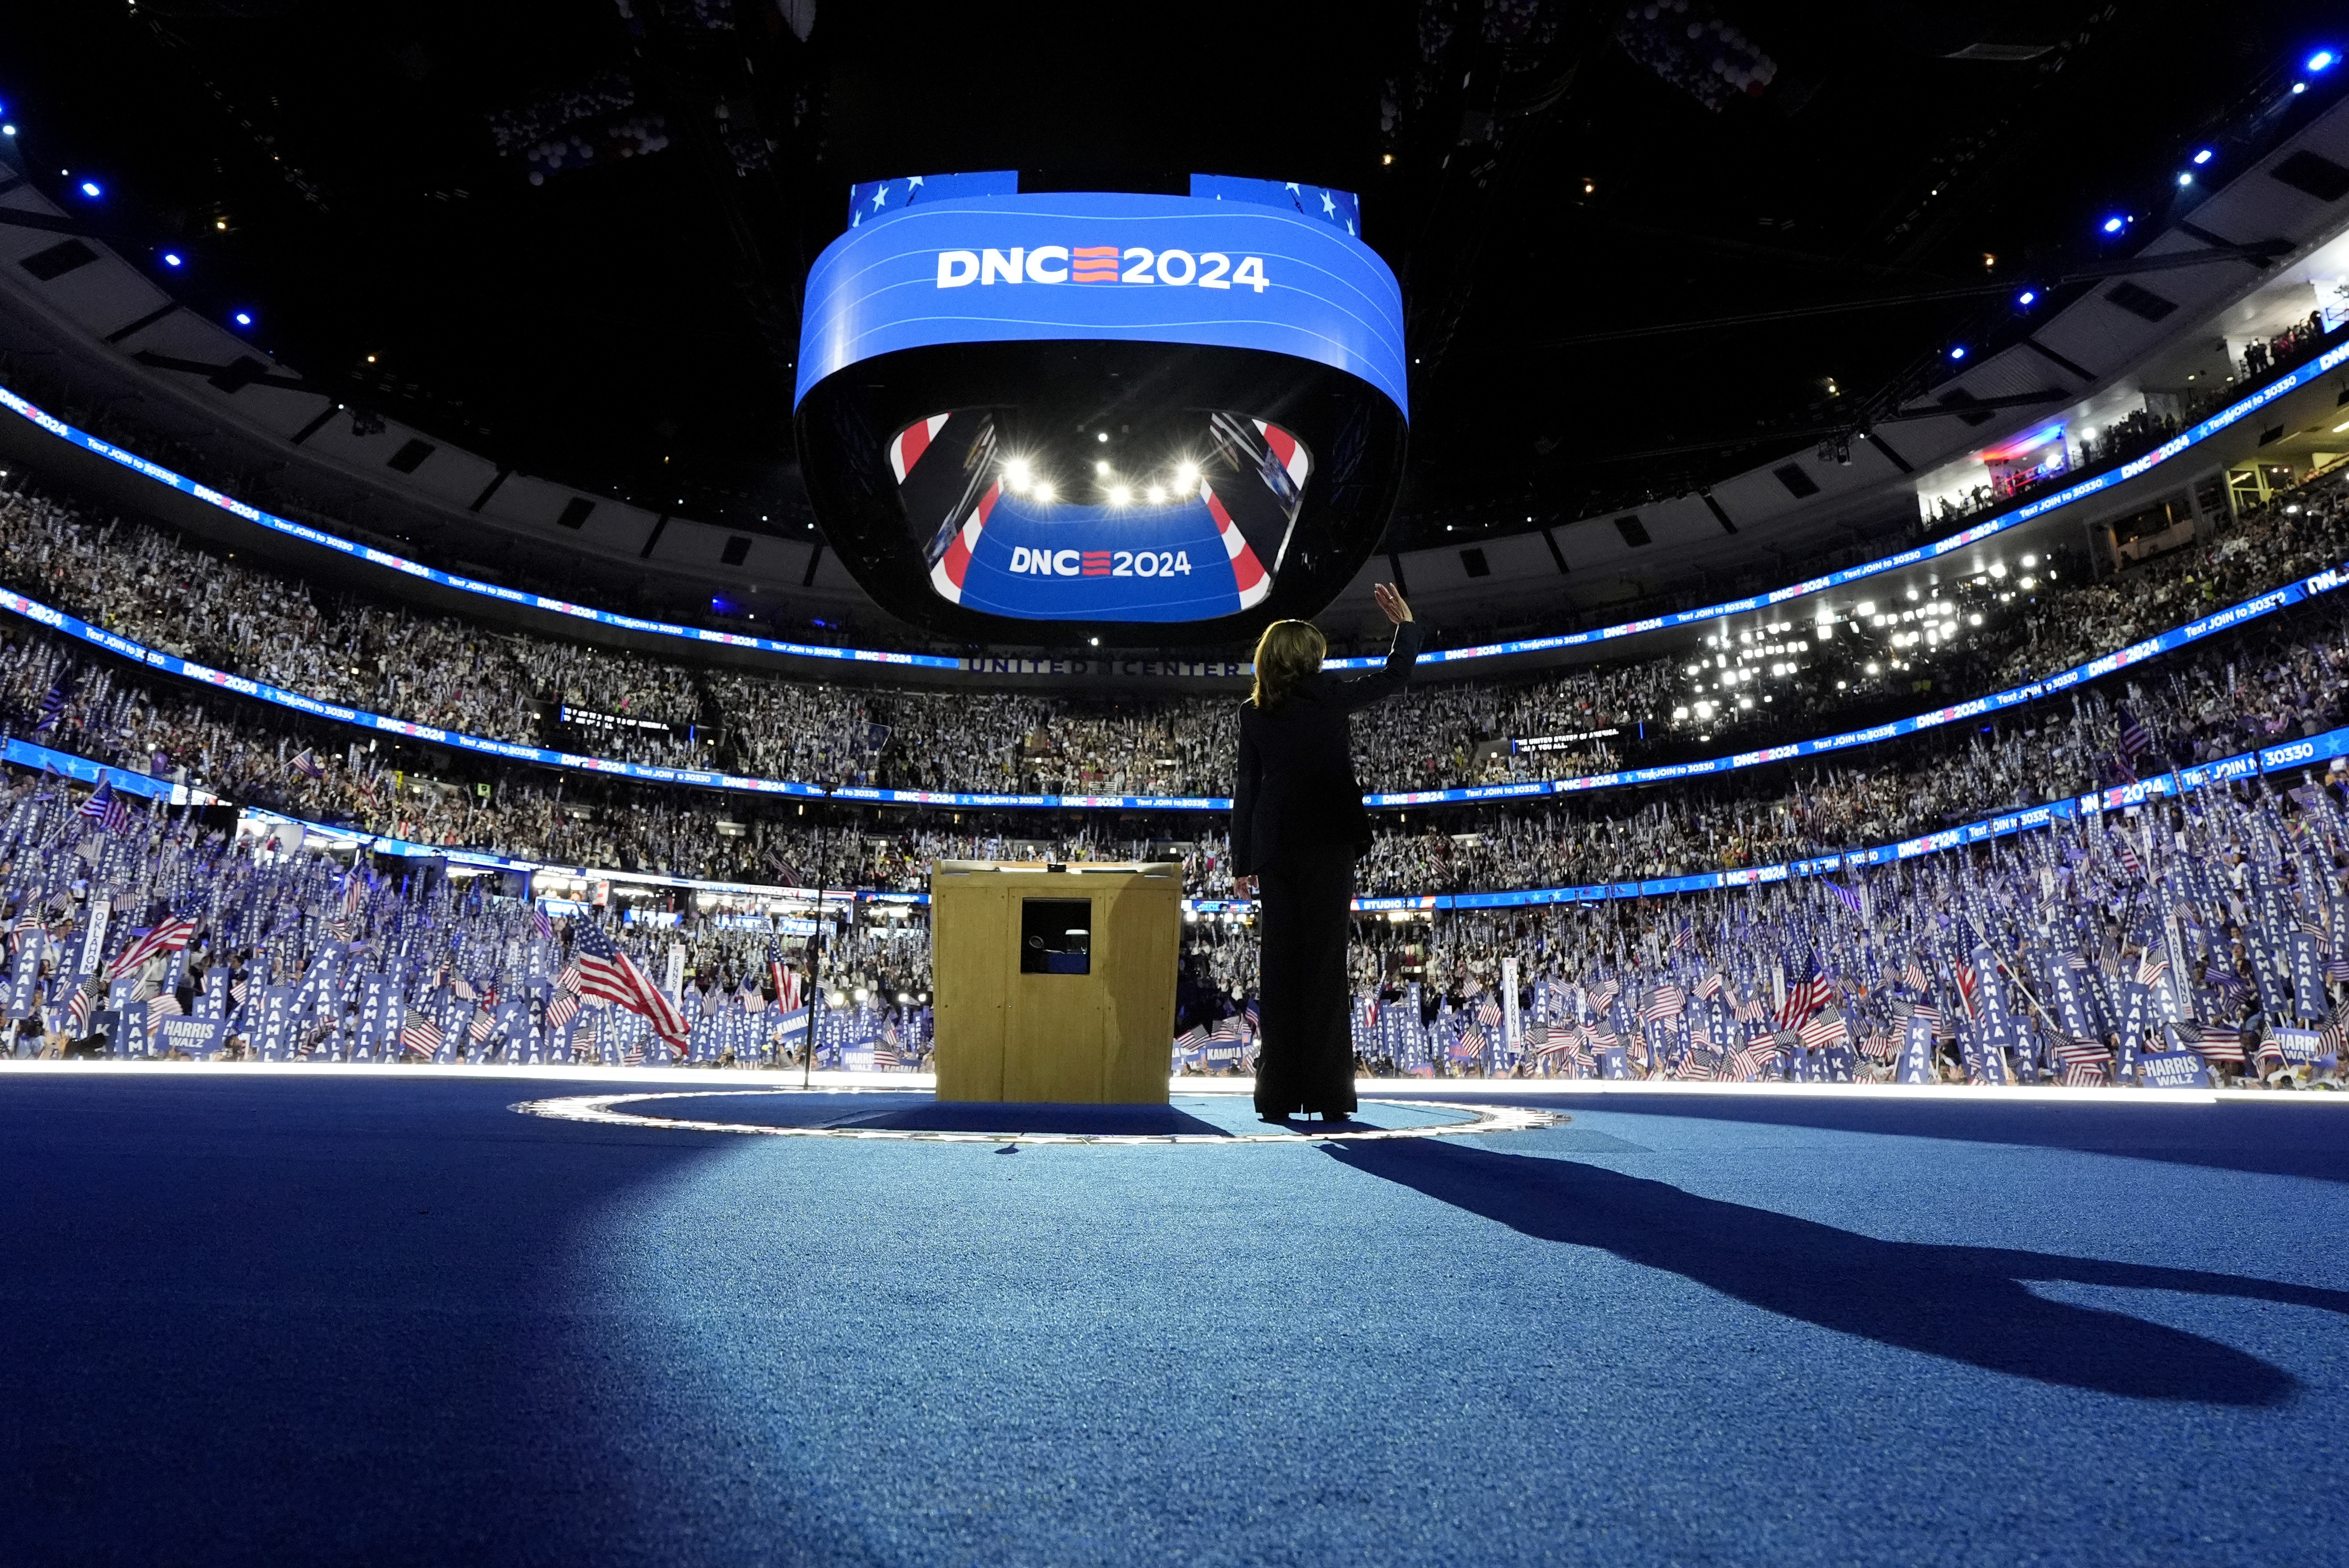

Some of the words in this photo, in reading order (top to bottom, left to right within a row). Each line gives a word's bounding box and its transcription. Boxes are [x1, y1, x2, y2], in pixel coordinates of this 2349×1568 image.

[937, 246, 1068, 288] DNC
[1122, 247, 1270, 293] 2024
[2252, 395, 2264, 405] to
[2264, 375, 2296, 400] 30330
[0, 389, 29, 414] DNC
[34, 411, 68, 436] 2024
[87, 438, 108, 453] Text
[108, 449, 133, 464] JOIN
[133, 459, 143, 469] to
[2121, 455, 2152, 479] DNC
[2158, 435, 2190, 460] 2024
[194, 485, 223, 505] DNC
[229, 501, 259, 521] 2024
[2019, 505, 2038, 518] Text
[2039, 495, 2061, 510] JOIN
[2062, 492, 2072, 501] to
[2073, 479, 2103, 497] 30330
[274, 519, 293, 531] Text
[293, 527, 316, 539] JOIN
[316, 534, 326, 542] to
[326, 536, 353, 551] 30330
[1935, 535, 1962, 554] DNC
[1967, 520, 1999, 541] 2024
[366, 549, 395, 566] DNC
[399, 560, 429, 577] 2024
[1009, 547, 1079, 576] DNC
[1112, 551, 1191, 577] 2024
[1843, 569, 1861, 579] Text
[1861, 562, 1882, 574] JOIN
[1893, 551, 1921, 565] 30330
[1769, 587, 1795, 603] DNC
[1799, 577, 1830, 593] 2024
[26, 602, 62, 627] 2024
[537, 597, 564, 611] DNC
[569, 605, 598, 619] 2024
[2184, 622, 2206, 637] Text
[2208, 611, 2235, 629] JOIN
[2235, 608, 2247, 618] to
[699, 630, 724, 642] DNC
[730, 635, 758, 647] 2024
[1603, 625, 1628, 638] DNC
[1635, 618, 1663, 632] 2024
[855, 650, 879, 661] DNC
[885, 653, 912, 664] 2024
[969, 660, 1088, 674] UNITED
[1123, 661, 1241, 676] CENTER
[1445, 649, 1469, 660] DNC
[1475, 645, 1502, 656] 2024
[2088, 655, 2118, 677] DNC
[2124, 639, 2160, 663] 2024
[183, 662, 216, 682] DNC
[224, 675, 257, 694] 2024
[376, 716, 407, 733] DNC
[415, 726, 446, 742] 2024
[1916, 710, 1945, 728] DNC
[1952, 699, 1986, 719] 2024
[459, 736, 476, 746] Text
[476, 741, 498, 751] JOIN
[1529, 736, 1553, 745] UNITED
[1733, 752, 1760, 767] DNC
[1767, 744, 1799, 760] 2024
[2265, 743, 2313, 766] 30330
[596, 760, 627, 774] 2024
[1555, 778, 1582, 792] DNC
[1589, 774, 1619, 787] 2024
[2214, 759, 2246, 779] JOIN
[722, 776, 749, 789] DNC
[756, 780, 786, 792] 2024
[894, 791, 921, 802] DNC
[927, 793, 956, 804] 2024
[1382, 794, 1409, 804] DNC
[1416, 791, 1445, 803] 2024
[1483, 788, 1503, 796] JOIN
[1514, 785, 1540, 793] 30330
[1061, 797, 1087, 807] DNC
[1094, 797, 1123, 807] 2024
[4, 804, 26, 842] KAMALA
[24, 808, 38, 845] KAMALA
[1898, 839, 1923, 858] DNC
[1928, 830, 1958, 850] 2024
[2309, 827, 2334, 872] KAMALA
[5, 848, 26, 892] KAMALA
[46, 854, 59, 894] KAMALA
[99, 844, 116, 881] KAMALA
[158, 845, 172, 888] NEVADA
[750, 887, 798, 897] DEMOCRACY
[2303, 859, 2316, 905] KAMALA
[1364, 900, 1401, 910] STUDIO
[2265, 890, 2281, 944] KAMALA
[84, 912, 104, 972] OKLAHOM
[1995, 921, 2014, 962] KAMALA
[2334, 903, 2346, 960] KAMALA
[12, 938, 38, 1010] KAMALA
[165, 951, 182, 994] AMALA
[2169, 928, 2188, 1004] MARYLAND
[2249, 937, 2282, 1005] KAMALA
[2298, 941, 2313, 1011] KAMALA
[245, 966, 264, 1026] KAMALA
[1538, 988, 1548, 1023] KAMA
[1979, 958, 2005, 1038] KAMALA
[2087, 973, 2116, 1027] KAMALA
[2109, 975, 2124, 1017] AMALA
[163, 1021, 215, 1039] HARRIS
[264, 997, 283, 1062] KAMAL
[357, 983, 380, 1058] KAMALA
[385, 996, 399, 1064] KAMALA
[527, 987, 542, 1065] KAMALA
[777, 1013, 808, 1035] KAMAL
[1618, 1001, 1631, 1032] KAMAL
[1711, 993, 1724, 1054] KAMAL
[169, 1036, 204, 1048] WALZ
[437, 1010, 466, 1064] KAMAL
[475, 1009, 518, 1065] KAMAL
[734, 1014, 746, 1056] KAMALA
[749, 1013, 760, 1055] AMALA
[2121, 993, 2143, 1076] KAMALA
[2275, 1033, 2320, 1050] HARRI
[845, 1052, 874, 1064] HARRI
[1207, 1047, 1242, 1060] KAMALA
[1908, 1028, 1925, 1084] KAMA
[2144, 1055, 2199, 1077] HARRIS
[2285, 1049, 2321, 1062] WALZ
[2156, 1073, 2195, 1087] WALZ
